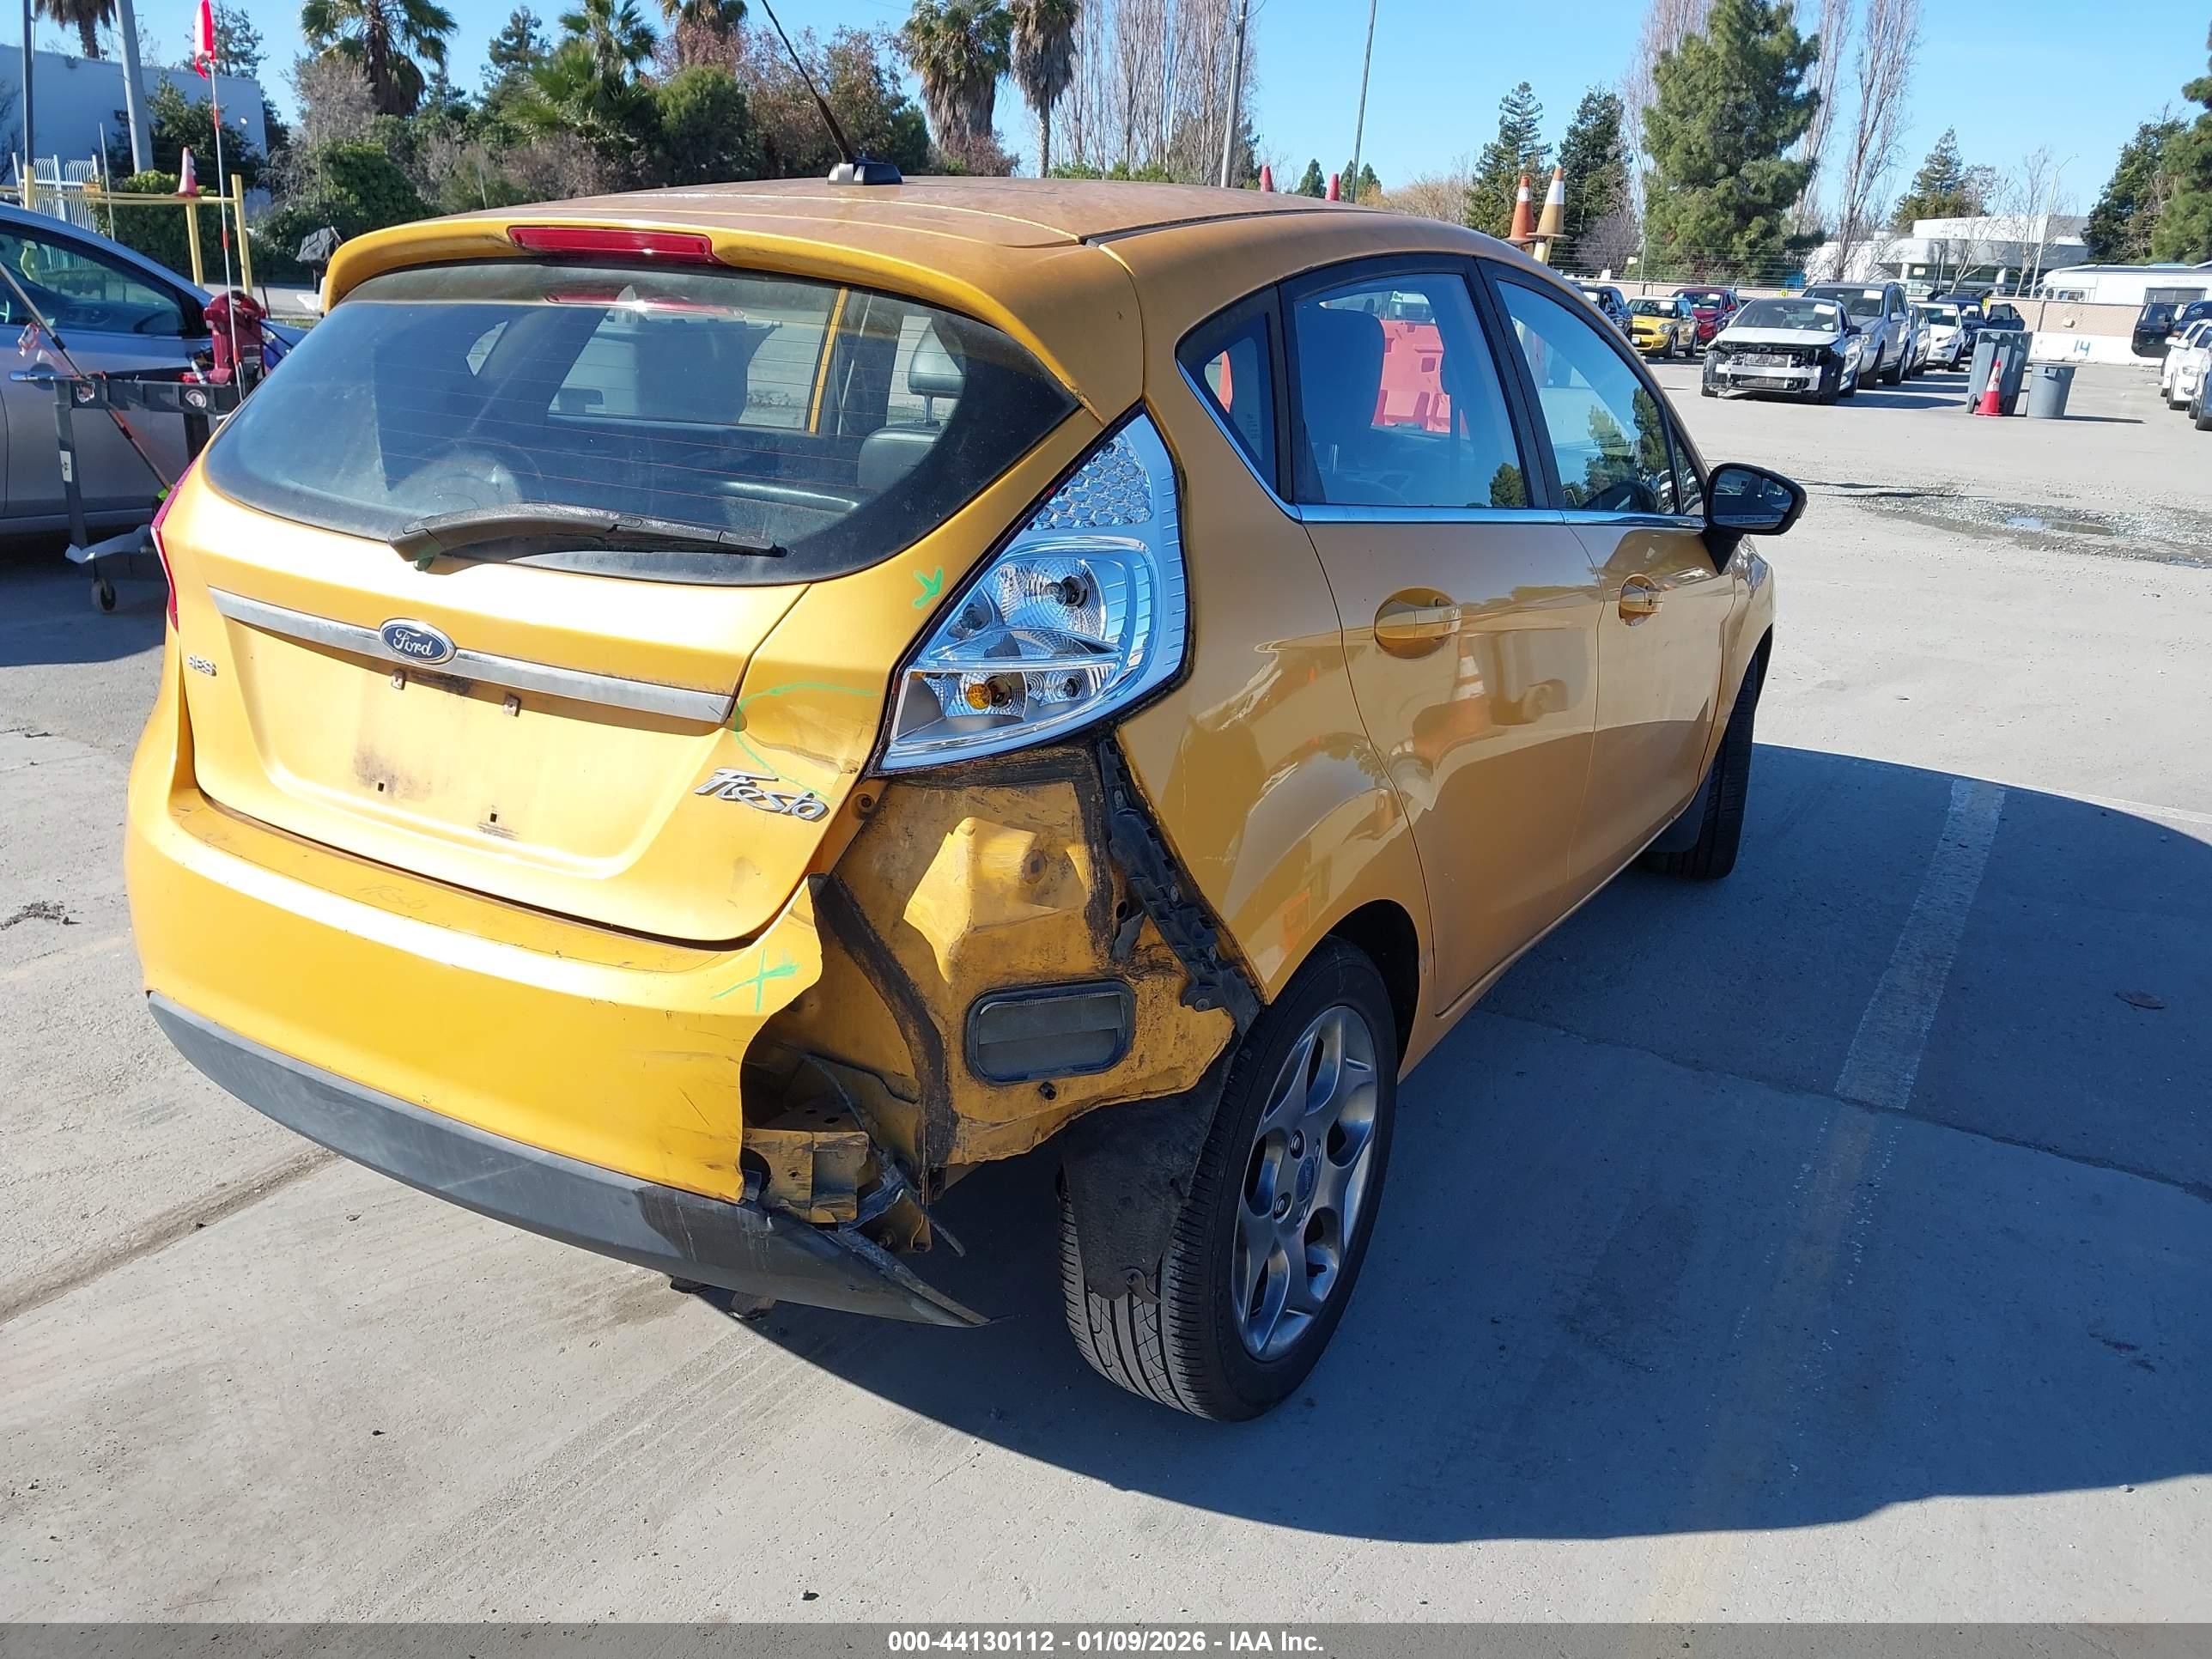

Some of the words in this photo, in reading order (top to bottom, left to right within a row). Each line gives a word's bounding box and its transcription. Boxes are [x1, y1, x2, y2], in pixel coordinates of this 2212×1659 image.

[2073, 339, 2091, 356] 14
[392, 628, 434, 656] Ford
[693, 768, 830, 823] Fiesta
